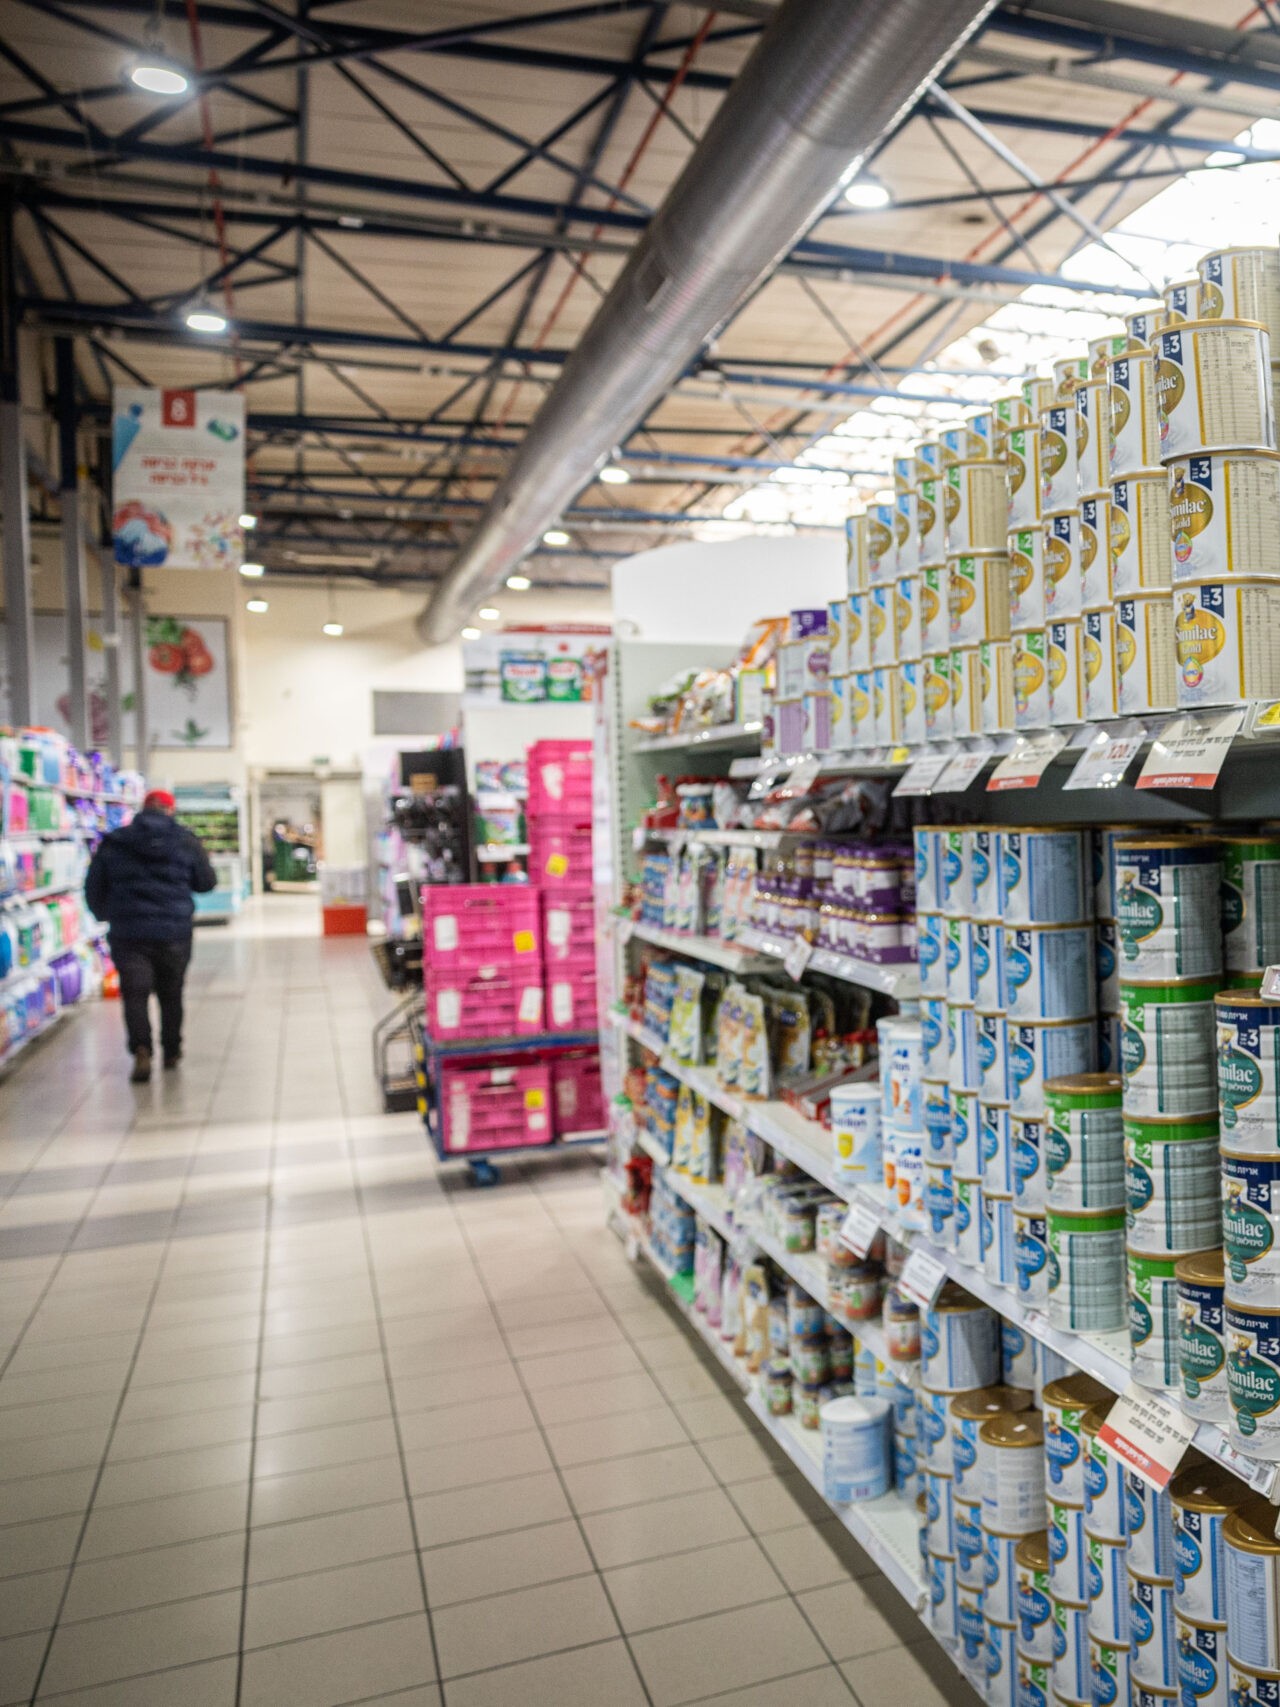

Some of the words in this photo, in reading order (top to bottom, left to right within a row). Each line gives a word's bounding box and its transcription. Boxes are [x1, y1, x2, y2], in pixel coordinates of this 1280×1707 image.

[1119, 362, 1128, 380] 3
[1199, 460, 1210, 478] 3
[1210, 588, 1222, 605] 3
[1149, 869, 1159, 885] 3
[1248, 1029, 1258, 1046] 3
[1258, 1184, 1269, 1201] 3
[1210, 1308, 1221, 1324] 3
[1268, 1338, 1280, 1355] 3
[1069, 1411, 1078, 1425] 2
[1190, 1514, 1200, 1530] 3
[1204, 1633, 1214, 1649] 3
[1266, 1683, 1278, 1699] 3
